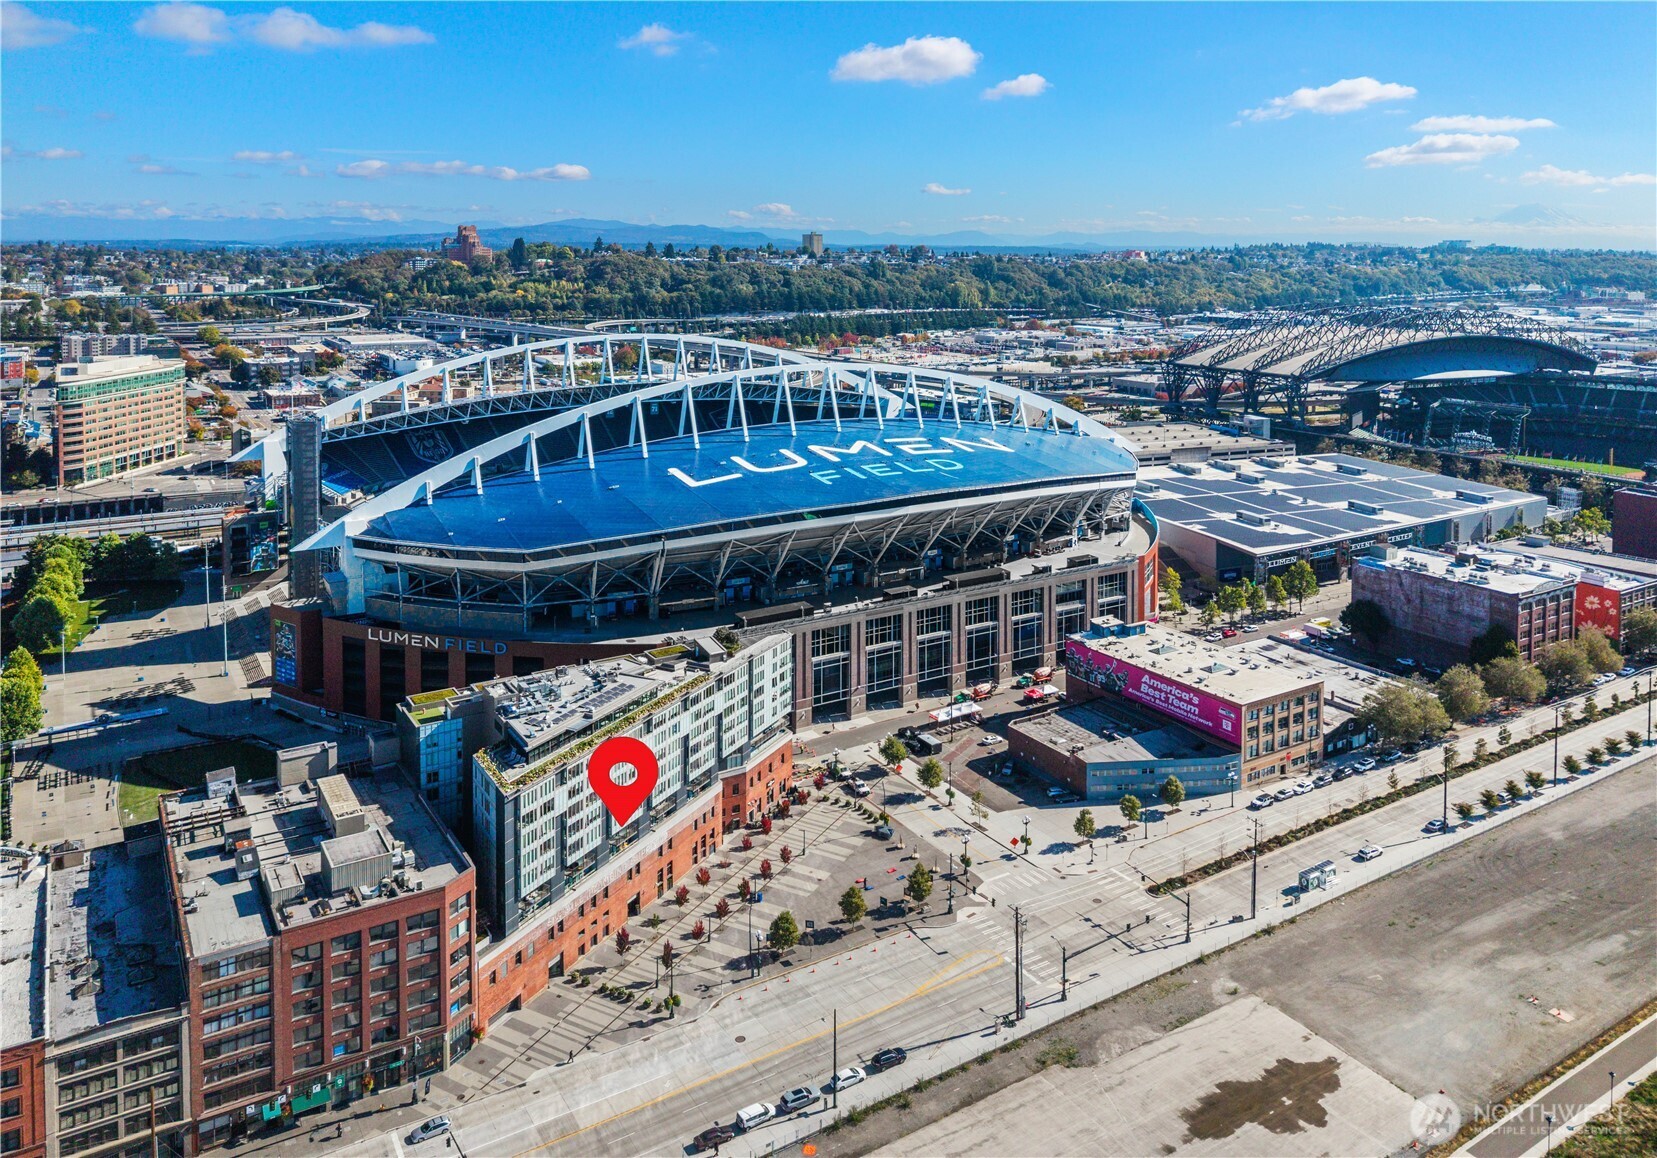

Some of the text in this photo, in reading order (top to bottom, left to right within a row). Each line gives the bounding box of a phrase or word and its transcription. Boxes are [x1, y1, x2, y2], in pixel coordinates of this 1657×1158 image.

[668, 437, 1015, 487] LUMEN
[810, 459, 964, 485] FIELD
[1268, 556, 1298, 568] LUMEN
[1352, 540, 1374, 550] EVENT
[1388, 532, 1413, 543] CENTER
[367, 628, 507, 655] LUMEN FIELD
[1140, 683, 1166, 700] Best
[1167, 693, 1199, 715] Team
[1141, 674, 1199, 704] America's
